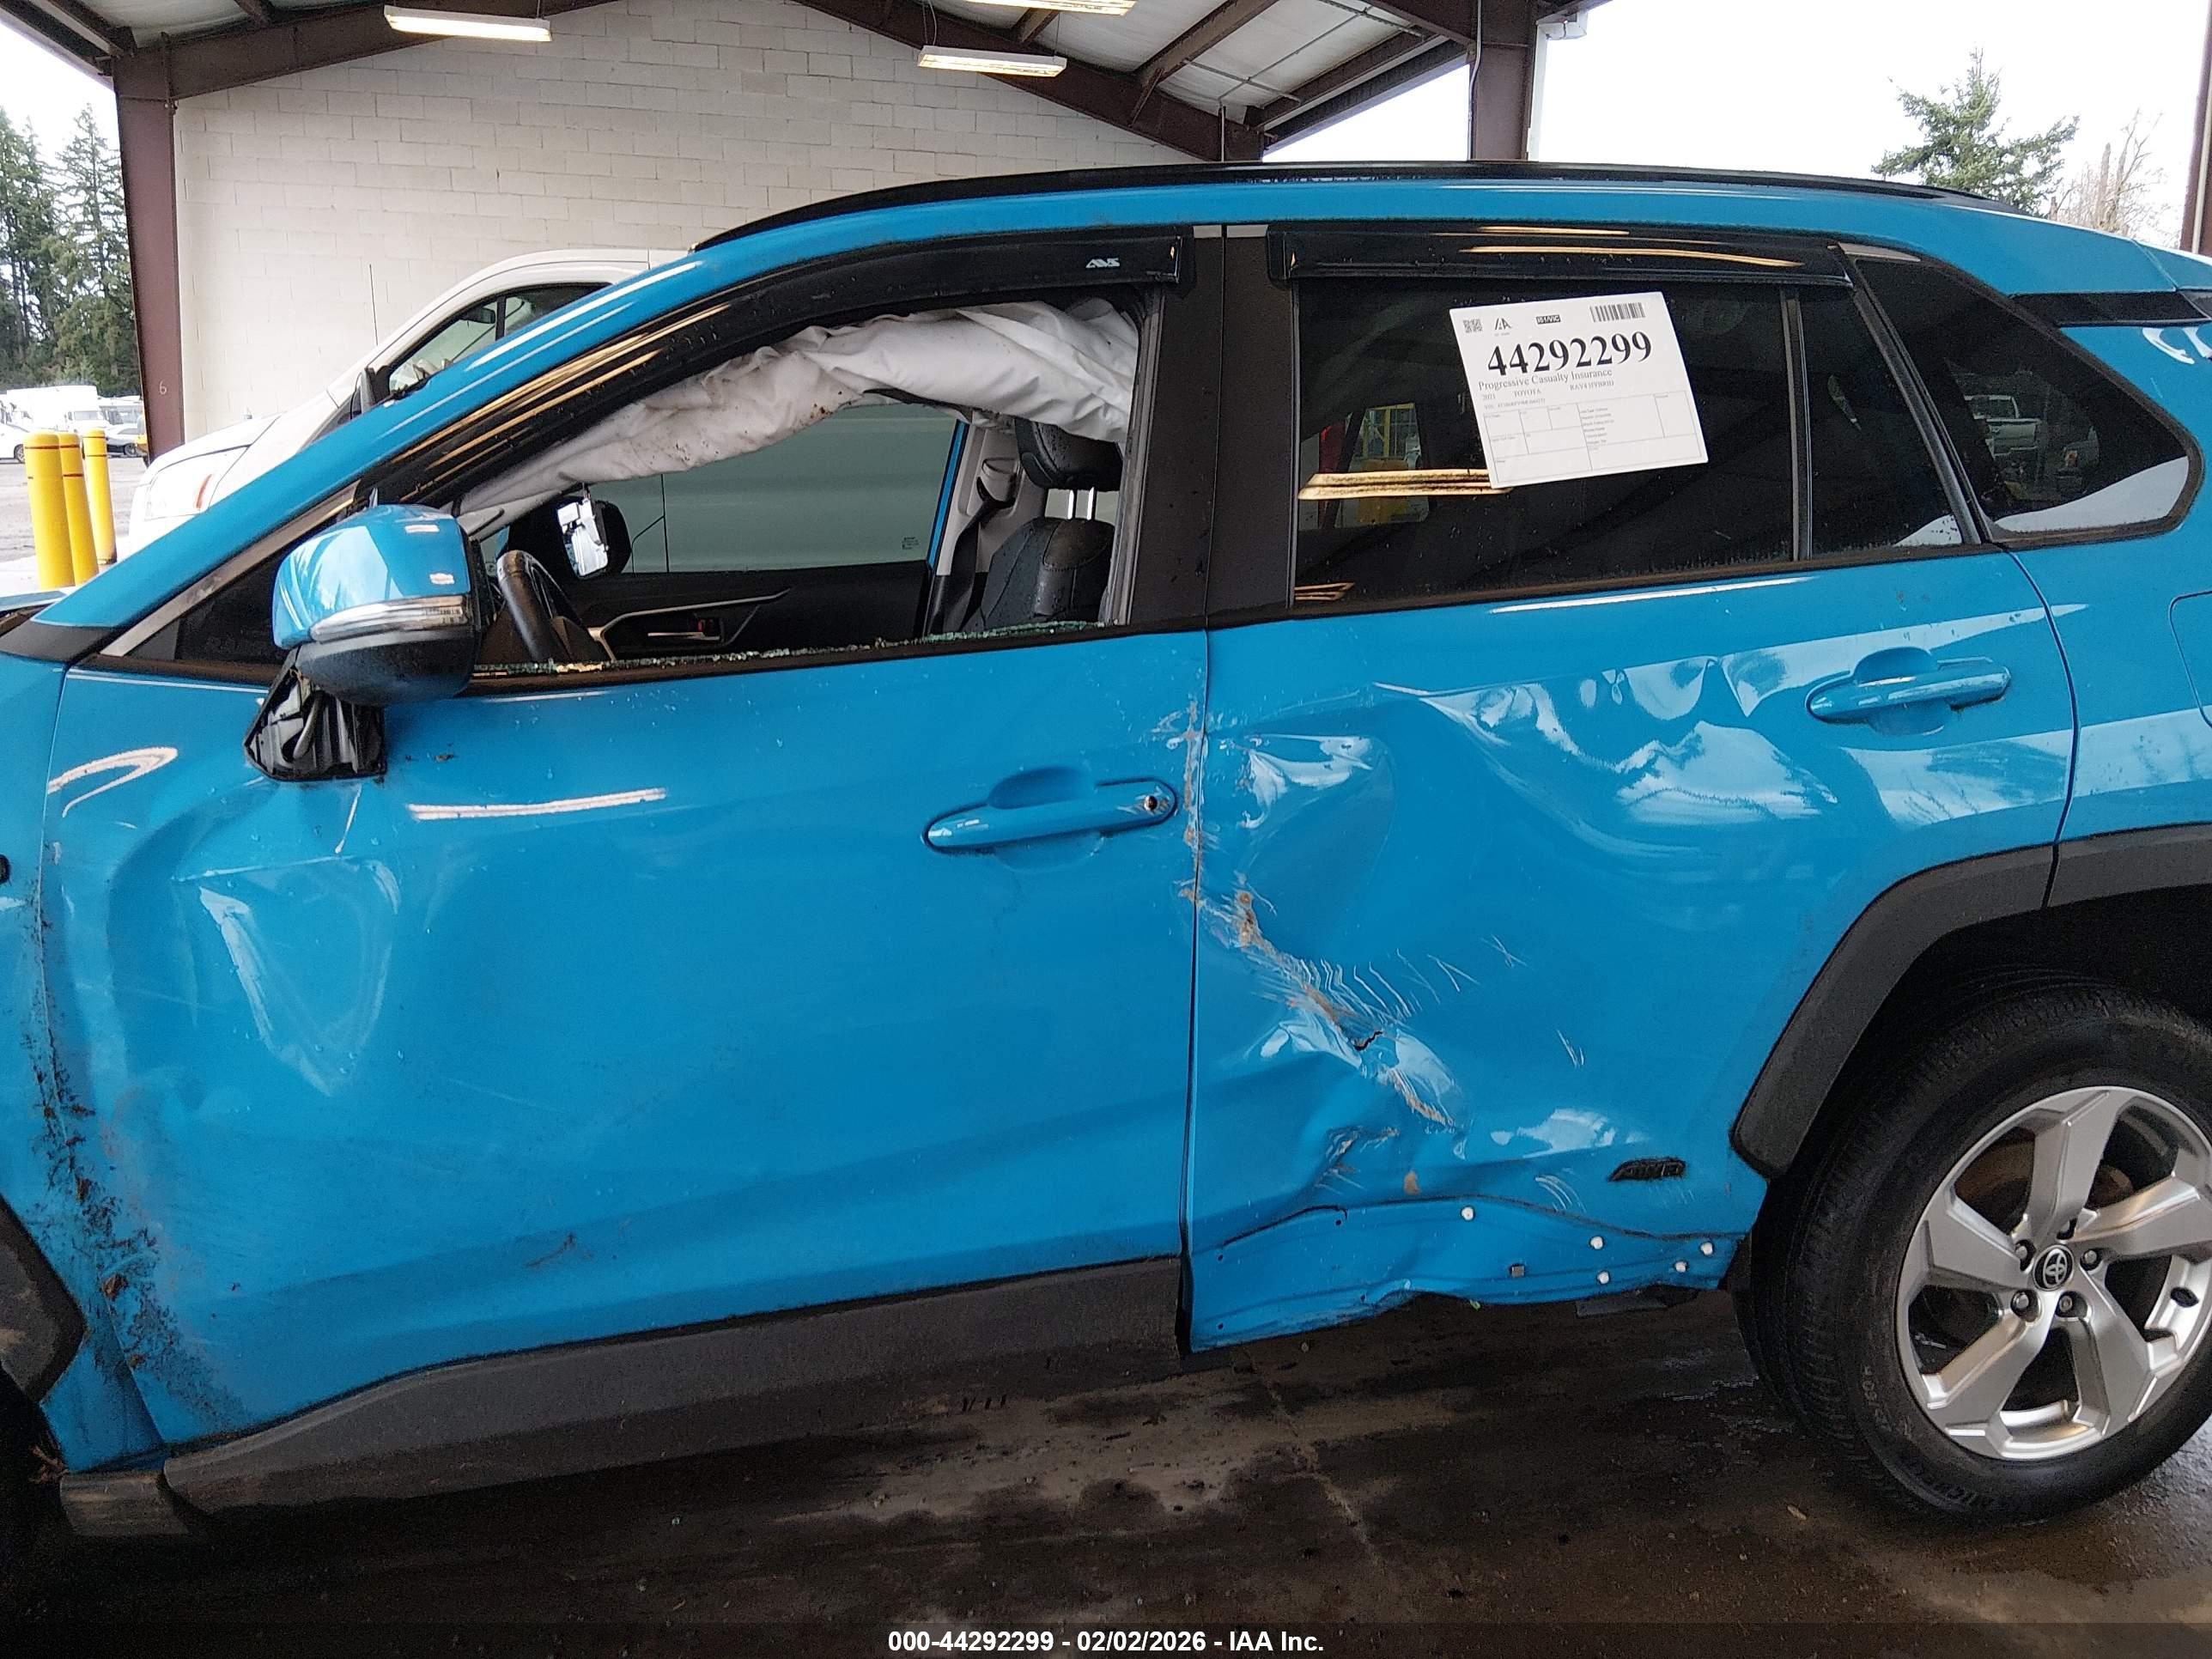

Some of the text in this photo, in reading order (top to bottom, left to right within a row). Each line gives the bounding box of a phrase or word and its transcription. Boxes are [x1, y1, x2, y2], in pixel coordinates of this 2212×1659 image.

[1488, 331, 1652, 375] 44292299
[1478, 368, 1613, 392] Progressive Casualty Insurance
[1513, 389, 1542, 398] TOYOTA
